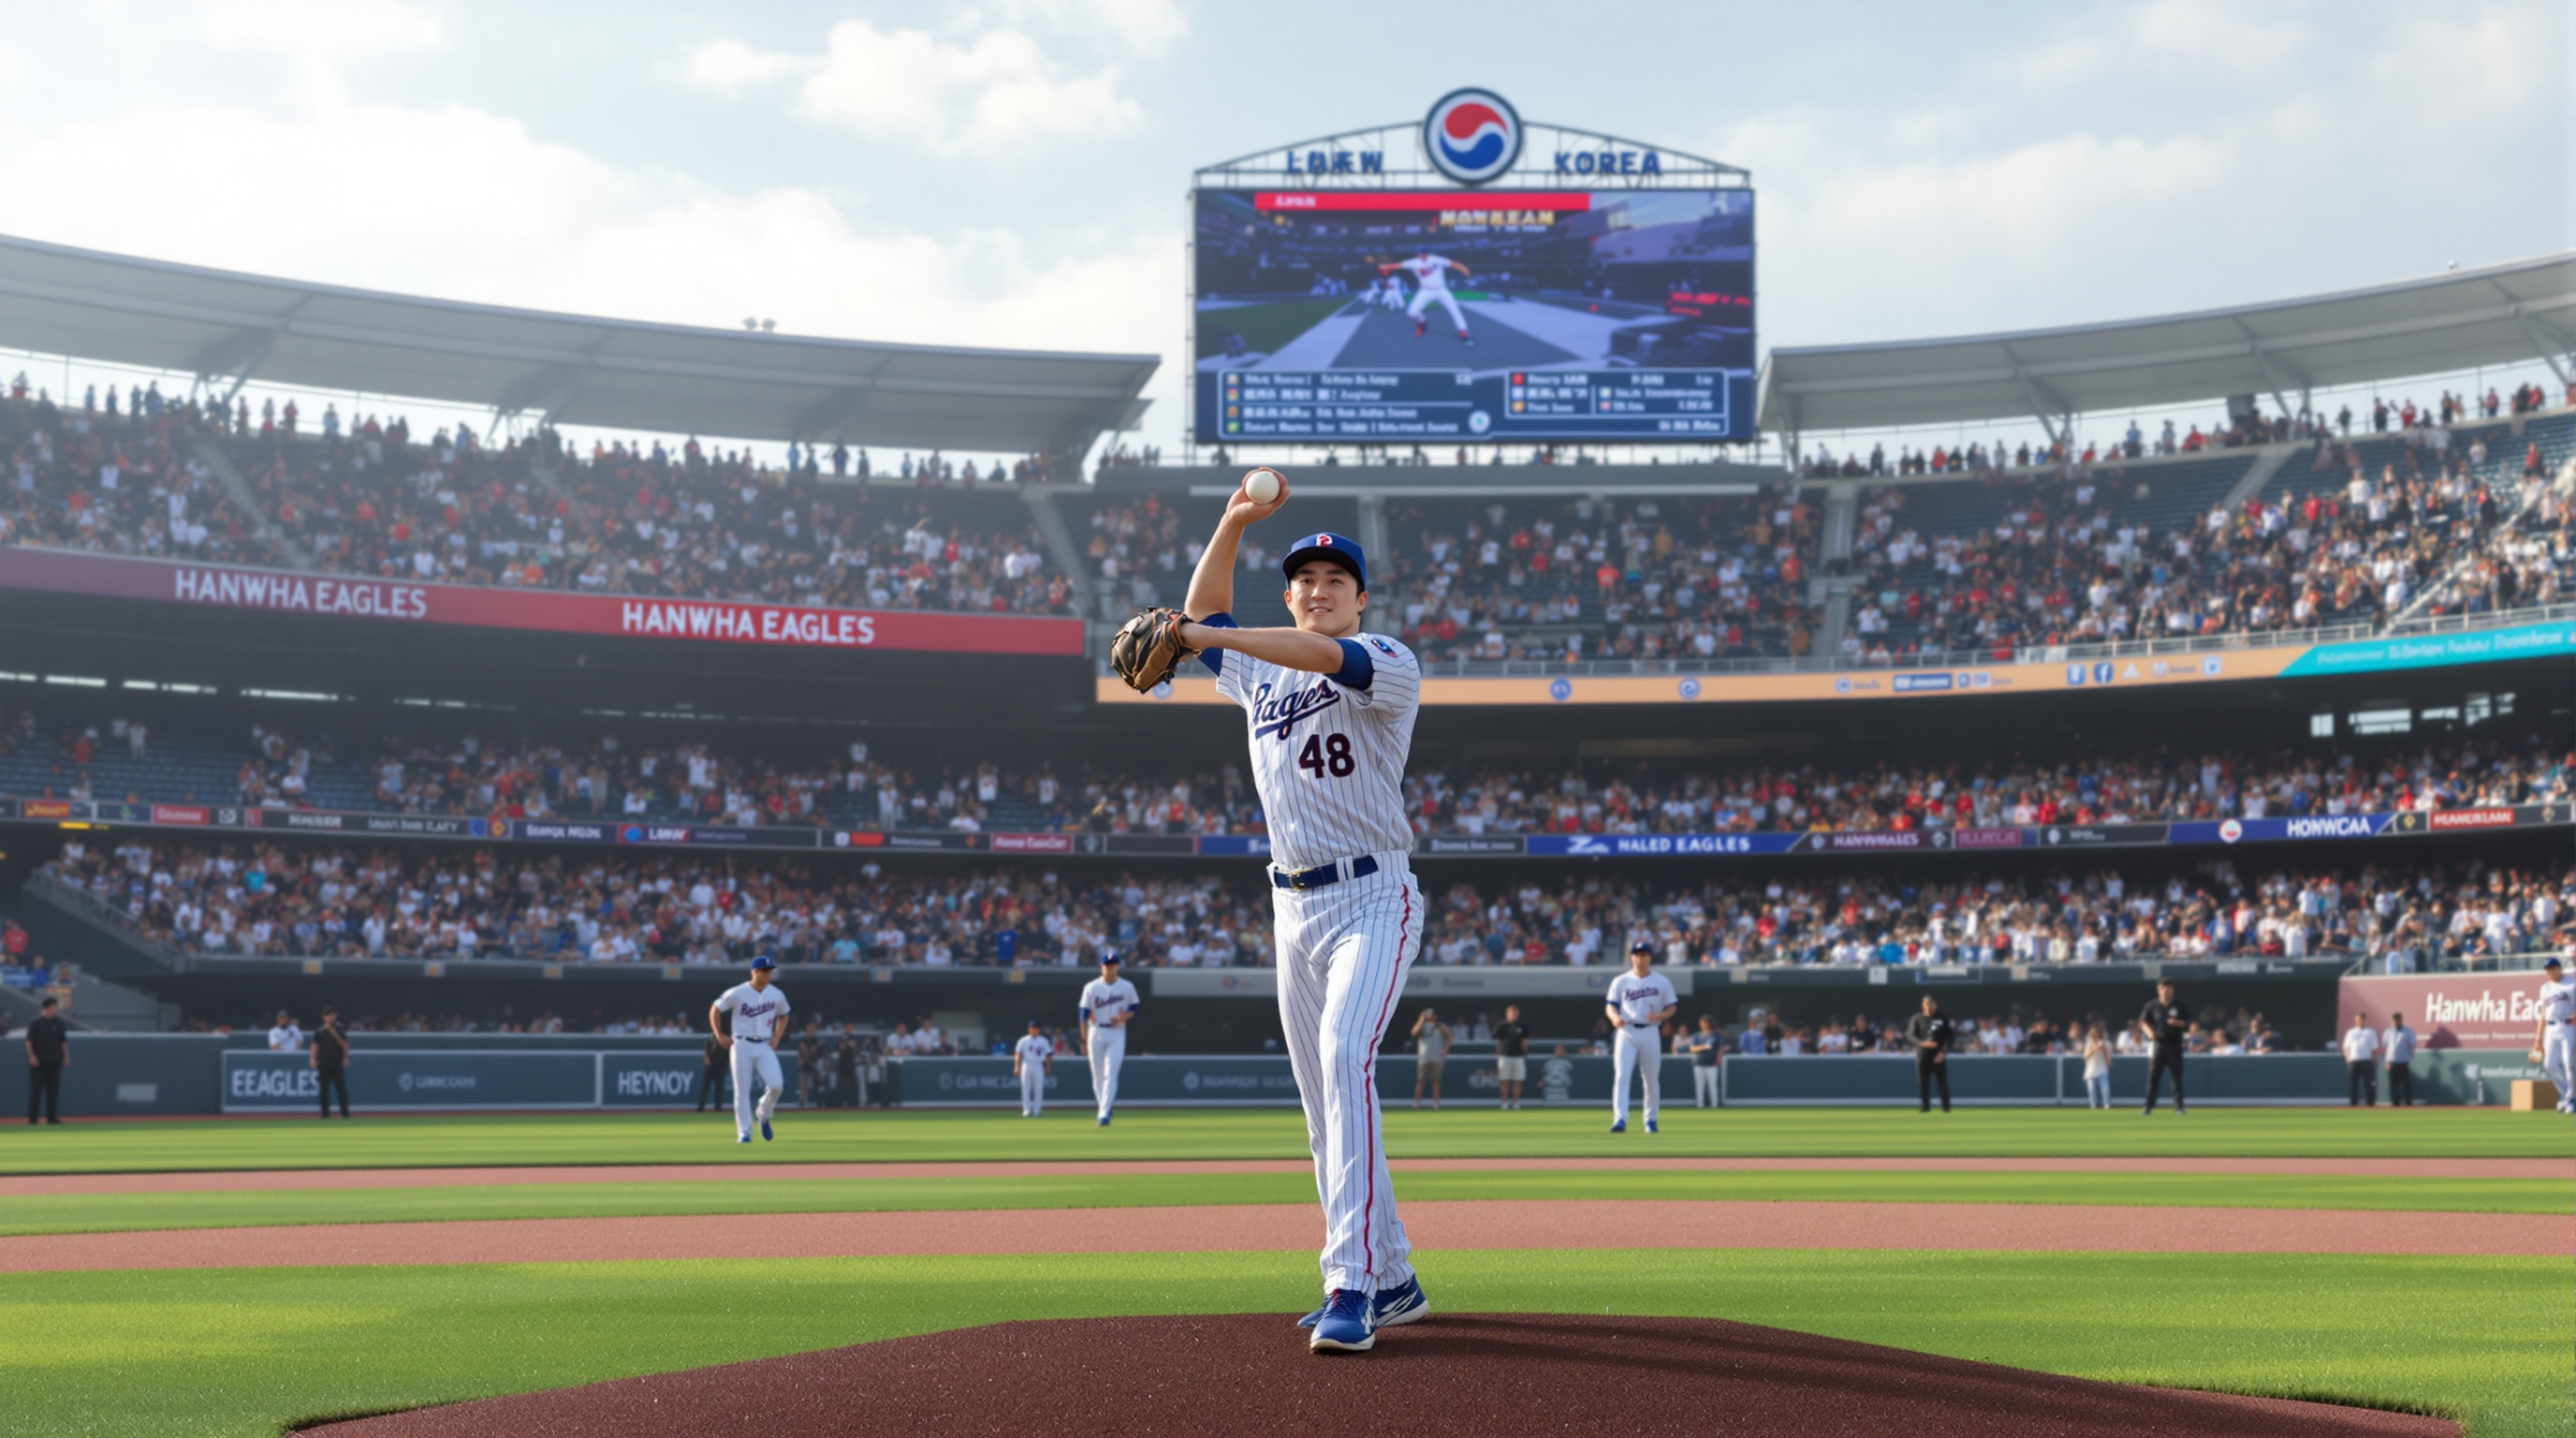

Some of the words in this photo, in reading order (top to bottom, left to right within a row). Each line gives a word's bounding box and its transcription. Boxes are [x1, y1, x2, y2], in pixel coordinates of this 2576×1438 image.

[1555, 151, 1661, 175] KOREA
[175, 568, 310, 609] HANWHA
[315, 581, 427, 618] EAGLES
[622, 602, 755, 638] HANWHA
[762, 611, 874, 644] EAGLES
[1299, 733, 1355, 779] 48
[1676, 836, 1750, 852] EAGLES
[2424, 990, 2507, 1022] Hanwha
[231, 1070, 320, 1096] EEAGLES
[618, 1071, 694, 1094] HEYNOY
